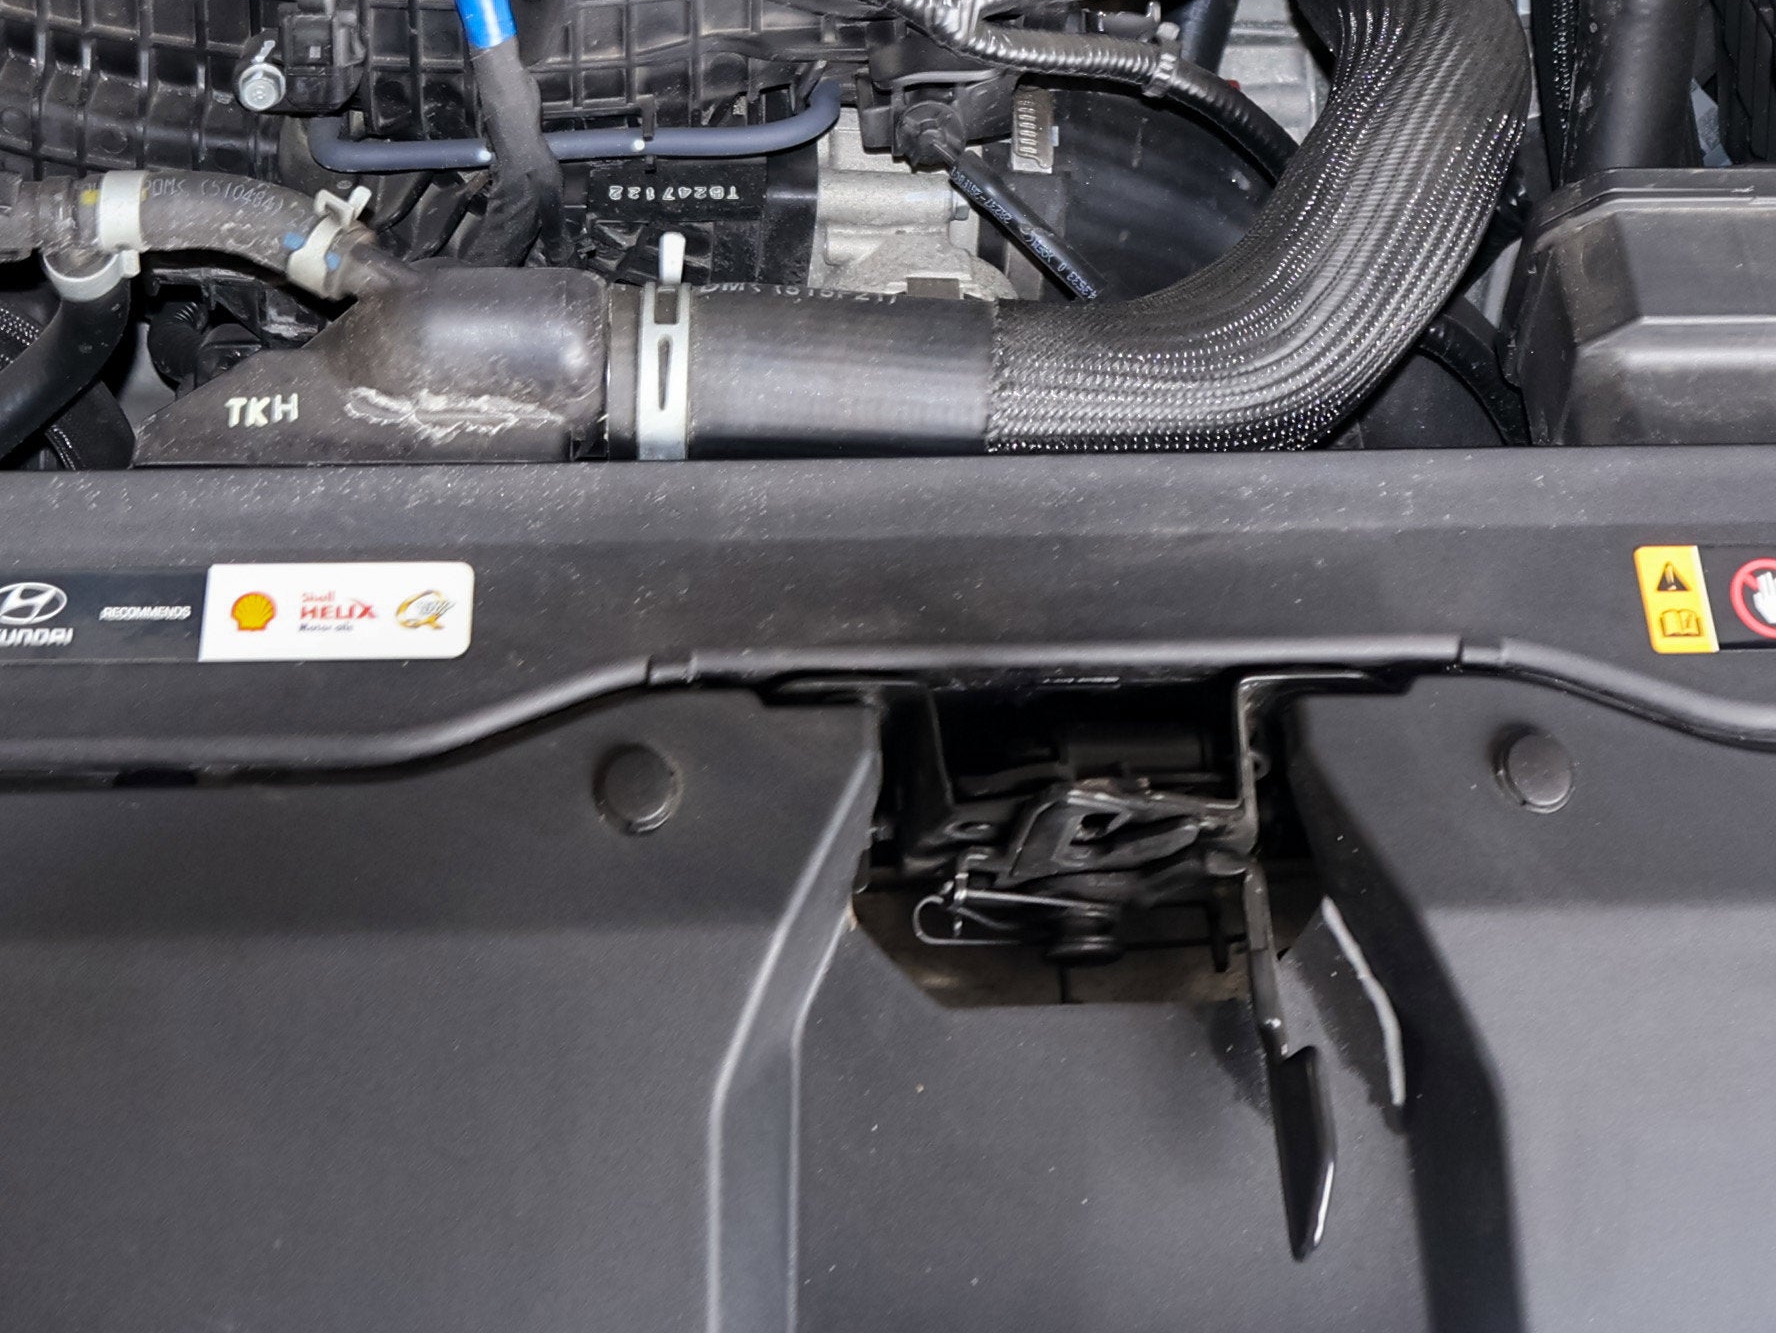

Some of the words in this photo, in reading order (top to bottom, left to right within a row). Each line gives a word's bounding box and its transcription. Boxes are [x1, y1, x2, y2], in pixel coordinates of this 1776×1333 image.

[224, 393, 299, 428] TKH
[99, 605, 192, 621] RECOMMENDS
[299, 598, 378, 620] HELIX
